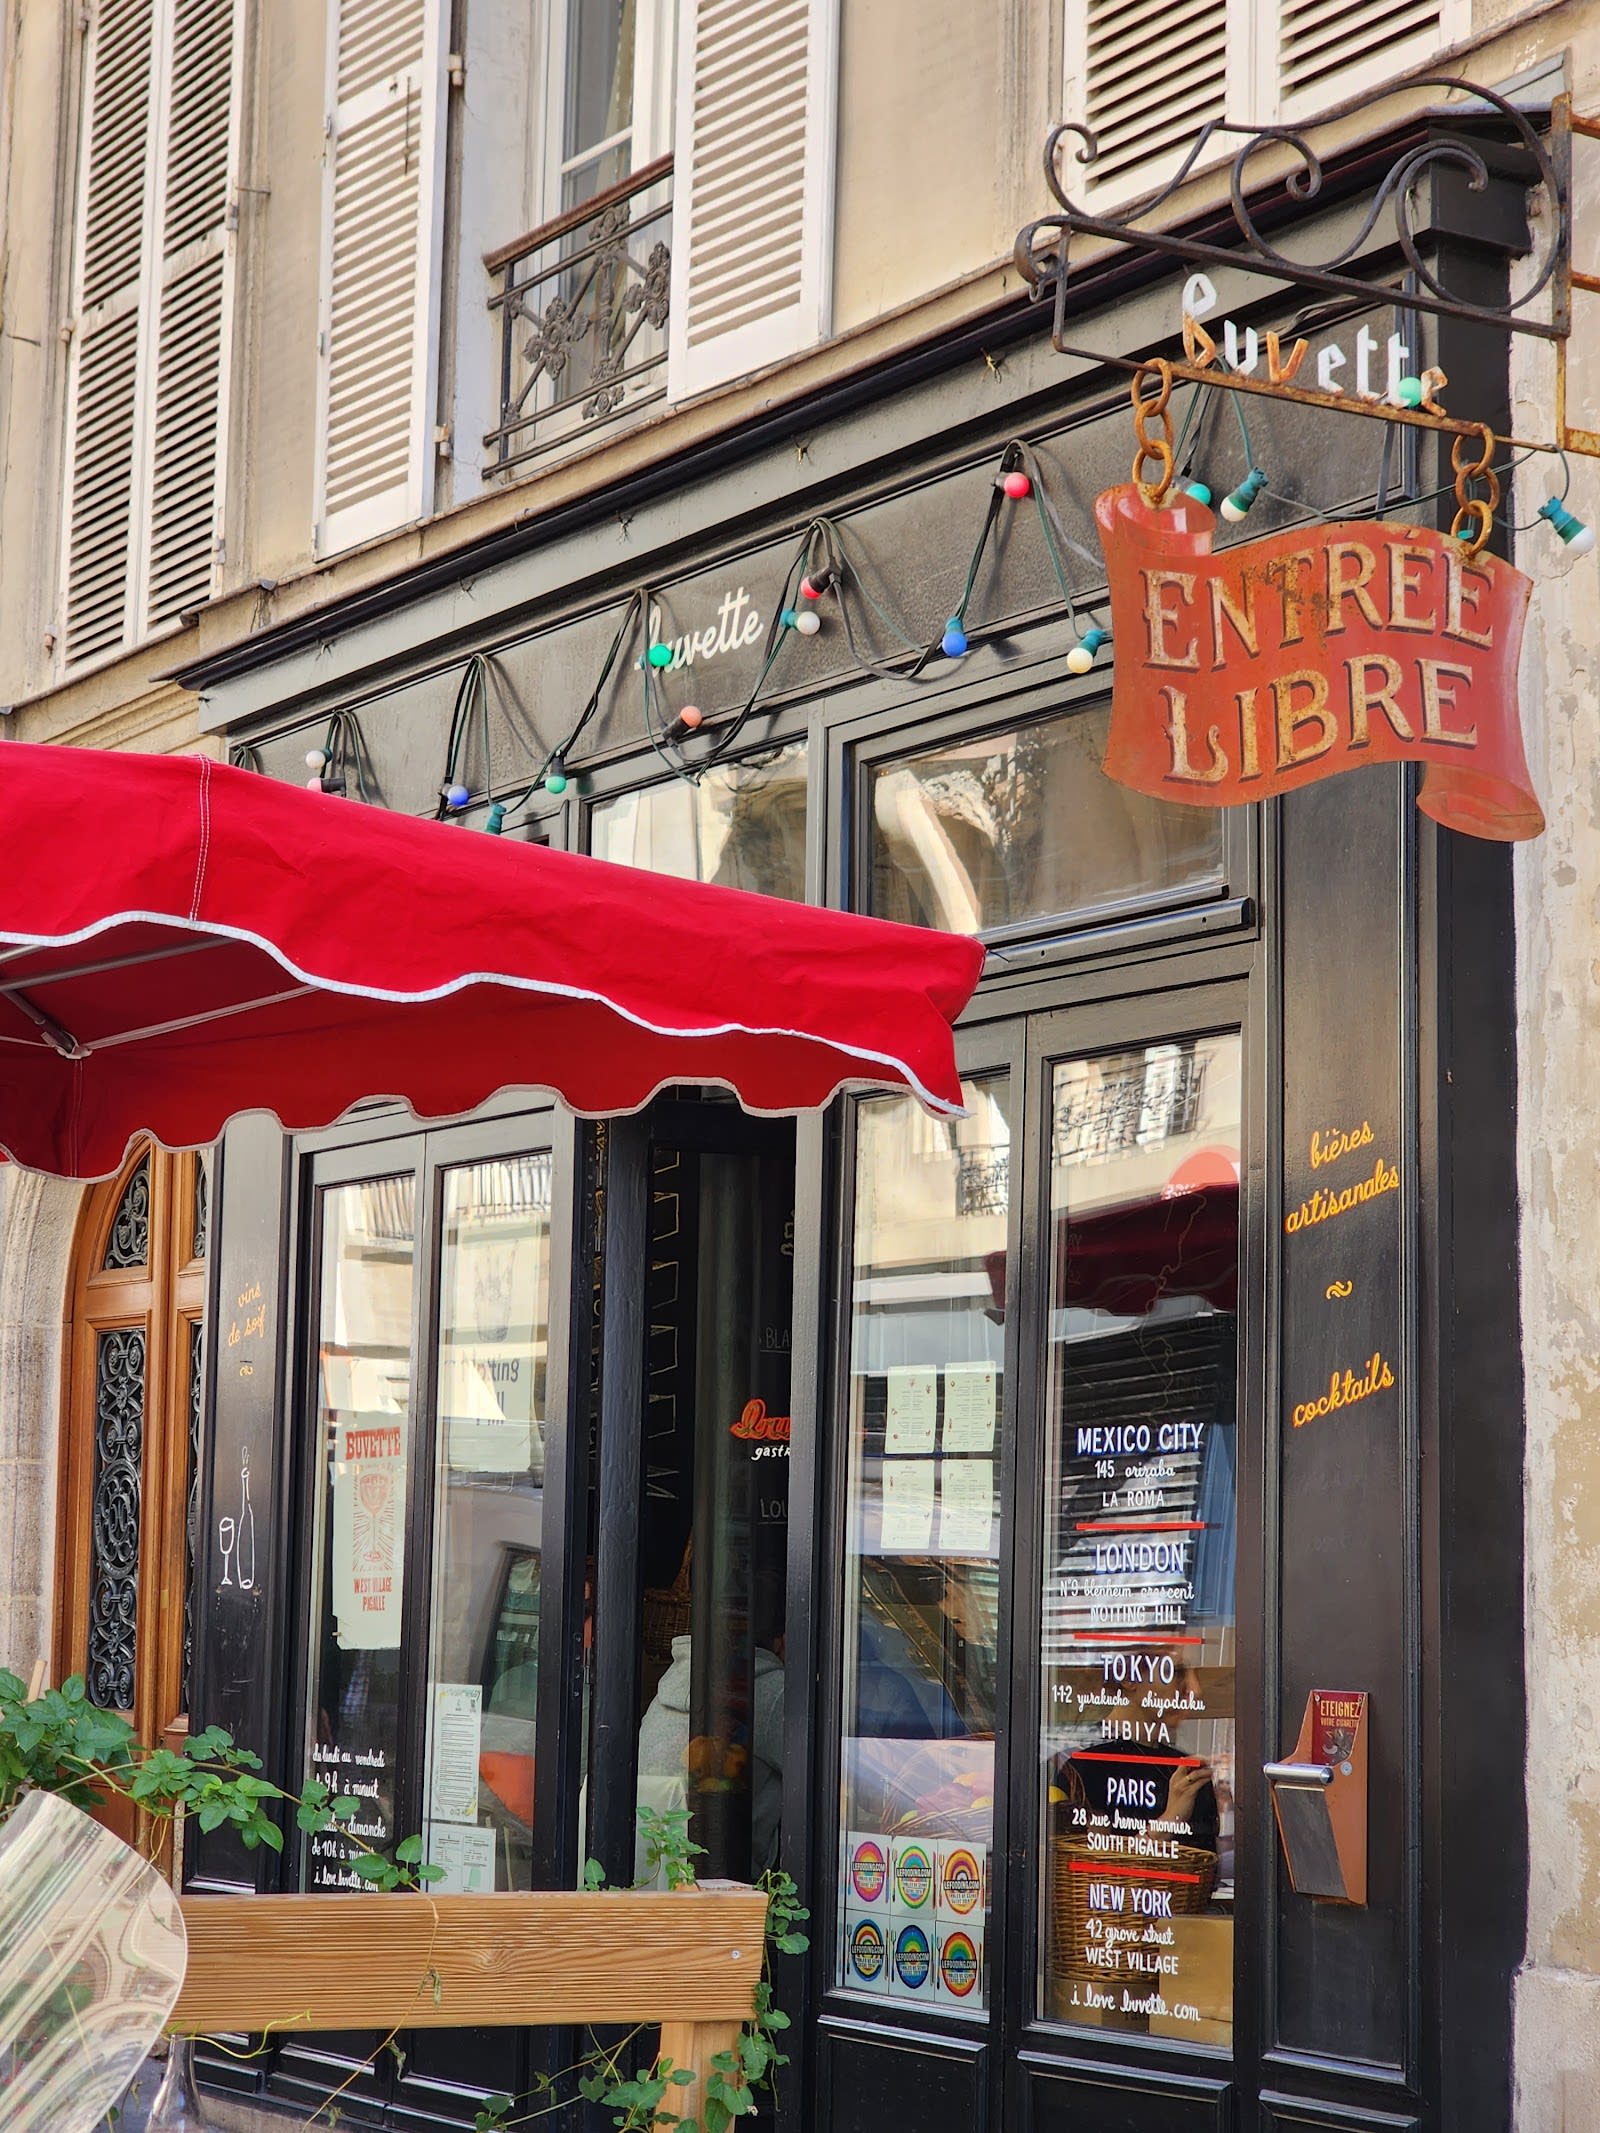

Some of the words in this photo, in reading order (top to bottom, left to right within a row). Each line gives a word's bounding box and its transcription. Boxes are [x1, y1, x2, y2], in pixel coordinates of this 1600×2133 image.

[1138, 528, 1497, 672] ENTRÉE
[1159, 653, 1478, 787] LIBRE
[1311, 1121, 1374, 1169] bières
[1285, 1159, 1399, 1233] artisanales
[238, 1281, 262, 1307] vins
[228, 1321, 240, 1347] de
[244, 1303, 266, 1338] soif
[345, 1426, 400, 1460] BUVETTE
[1077, 1424, 1151, 1454] MEXICO
[1158, 1422, 1204, 1451] CITY
[1095, 1460, 1114, 1478] 145
[1125, 1459, 1176, 1486] orizaba
[1102, 1491, 1118, 1507] LA
[1127, 1490, 1165, 1507] ROMA
[1095, 1543, 1184, 1573] LONDON
[1084, 1579, 1131, 1597] blenheim
[1141, 1581, 1194, 1600] crescent
[1090, 1605, 1145, 1623] NOTTING
[1155, 1605, 1186, 1624] HILL
[1101, 1654, 1174, 1684] TOKYO
[1077, 1688, 1130, 1712] yurakucho
[1141, 1690, 1205, 1718] chiyodaku
[1320, 1700, 1360, 1718] ETEIGNEZ
[1102, 1720, 1170, 1743] HIBIYA
[322, 1744, 340, 1763] lundi
[341, 1752, 352, 1763] au
[355, 1748, 385, 1768] vendredi
[324, 1770, 338, 1794] 9h
[343, 1778, 351, 1795] à
[352, 1777, 379, 1799] minuit
[1107, 1777, 1156, 1807] PARIS
[347, 1813, 386, 1838] dimanche
[1072, 1808, 1087, 1826] 28
[1090, 1813, 1110, 1827] rue
[1112, 1808, 1147, 1835] henry
[1148, 1816, 1193, 1835] monnier
[312, 1836, 321, 1856] de
[321, 1840, 337, 1859] 10h
[339, 1842, 345, 1859] à
[1087, 1832, 1124, 1853] SOUTH
[1128, 1836, 1179, 1859] PIGALLE
[314, 1866, 320, 1884] i
[853, 1863, 885, 1871] LEFOODING.COM
[897, 1869, 930, 1877] LEFOODING.COM
[945, 1881, 979, 1889] LEFOODING.COM
[1089, 1884, 1125, 1912] NEW
[1131, 1888, 1172, 1918] YORK
[1085, 1918, 1102, 1939] 42
[1105, 1926, 1139, 1948] grove
[1141, 1924, 1175, 1945] street
[852, 1945, 884, 1954] LEFOODING.COM
[896, 1953, 929, 1961] LEFOODING.COM
[1086, 1947, 1121, 1969] WEST
[1127, 1953, 1178, 1975] VILLAGE
[942, 1960, 976, 1969] LEFOODING.COM
[1070, 1985, 1080, 2006] i
[1083, 1984, 1115, 2010] love
